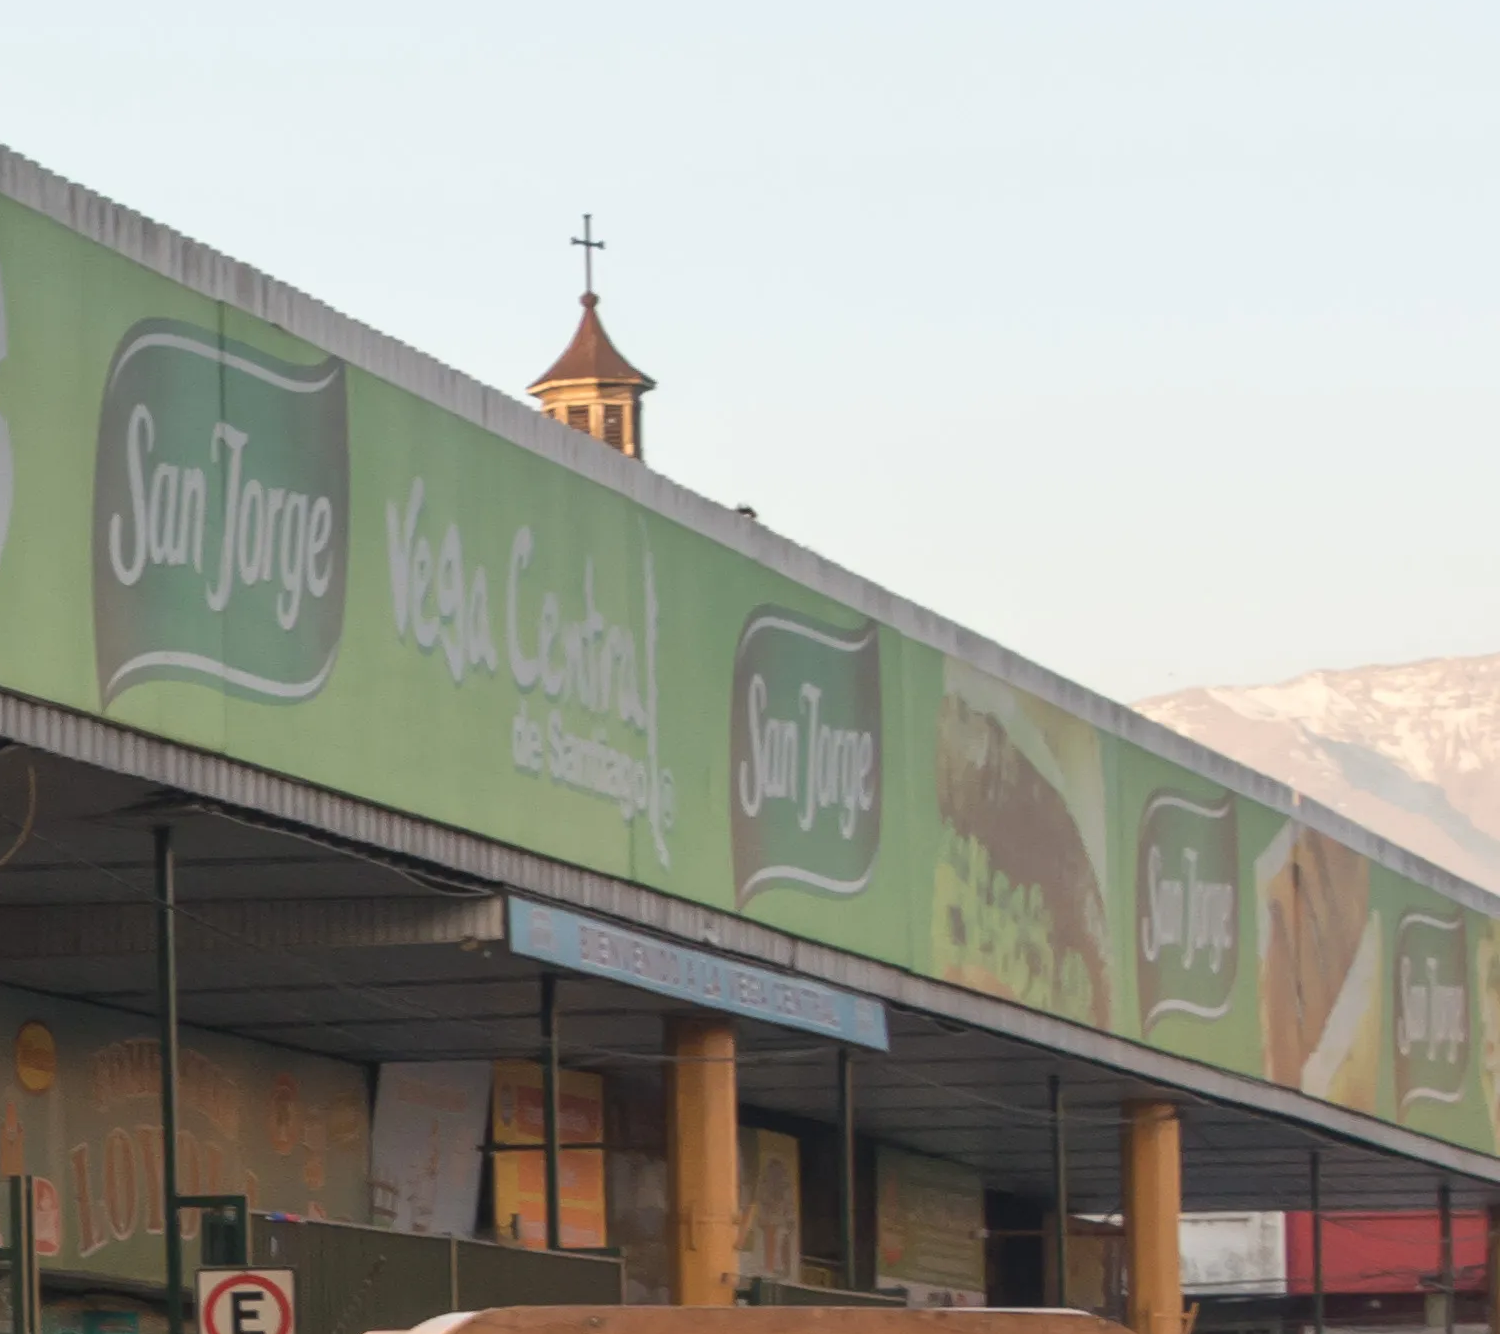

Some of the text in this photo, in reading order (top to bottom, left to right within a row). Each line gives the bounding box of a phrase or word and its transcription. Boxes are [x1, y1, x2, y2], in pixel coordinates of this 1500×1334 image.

[107, 403, 335, 631] San Jorge
[385, 475, 498, 685] Vega
[739, 672, 875, 840] San Jorge
